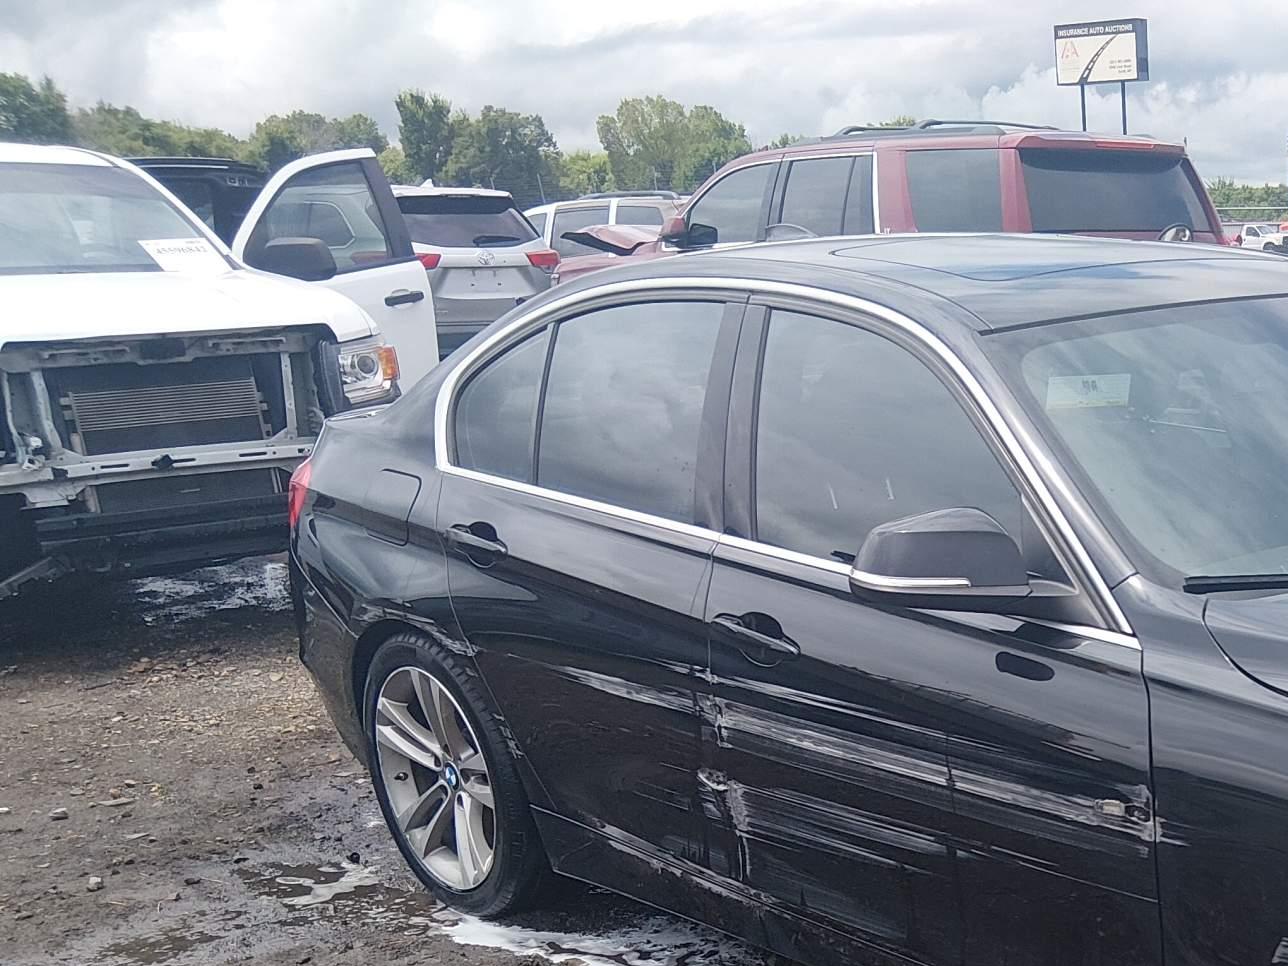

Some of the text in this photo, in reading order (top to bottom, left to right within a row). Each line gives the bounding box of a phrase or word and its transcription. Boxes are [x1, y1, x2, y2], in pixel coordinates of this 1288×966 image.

[1058, 24, 1133, 37] INSURANCE AUTO AUCTIONS
